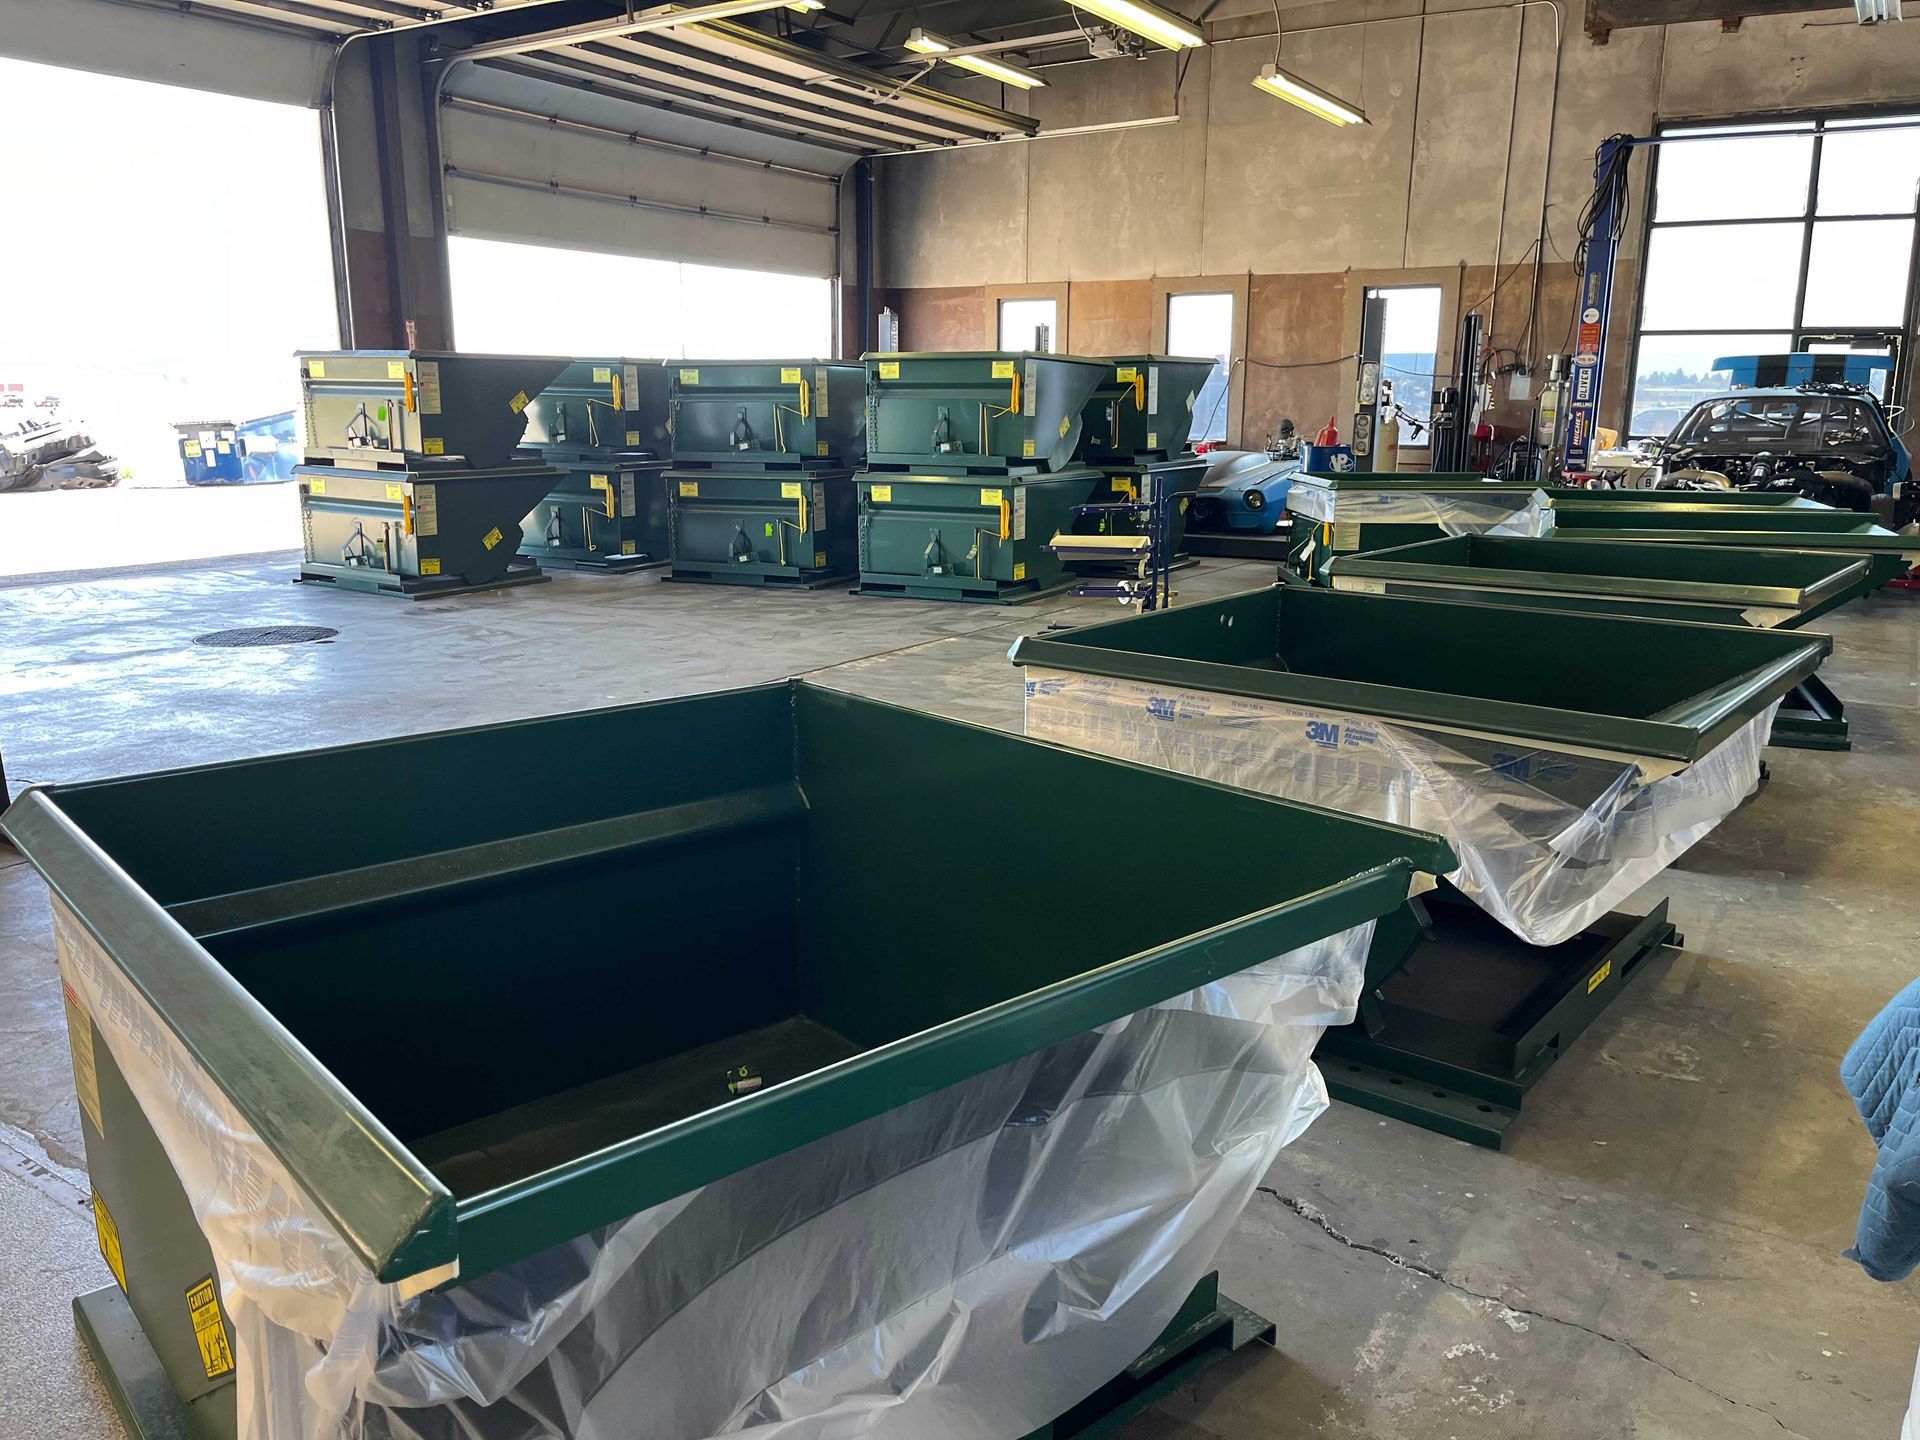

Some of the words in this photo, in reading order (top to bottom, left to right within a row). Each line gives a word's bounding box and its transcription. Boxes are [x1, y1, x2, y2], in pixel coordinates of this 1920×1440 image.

[1579, 370, 1590, 398] OLIVER
[1573, 411, 1583, 445] HUGHES
[1146, 697, 1176, 716] 3M
[1305, 721, 1339, 743] 3M
[1344, 727, 1379, 738] Advanced
[1344, 733, 1374, 744] Masking
[1344, 739, 1360, 747] Film
[1490, 753, 1531, 780] 3M
[190, 1285, 214, 1311] CAUTION
